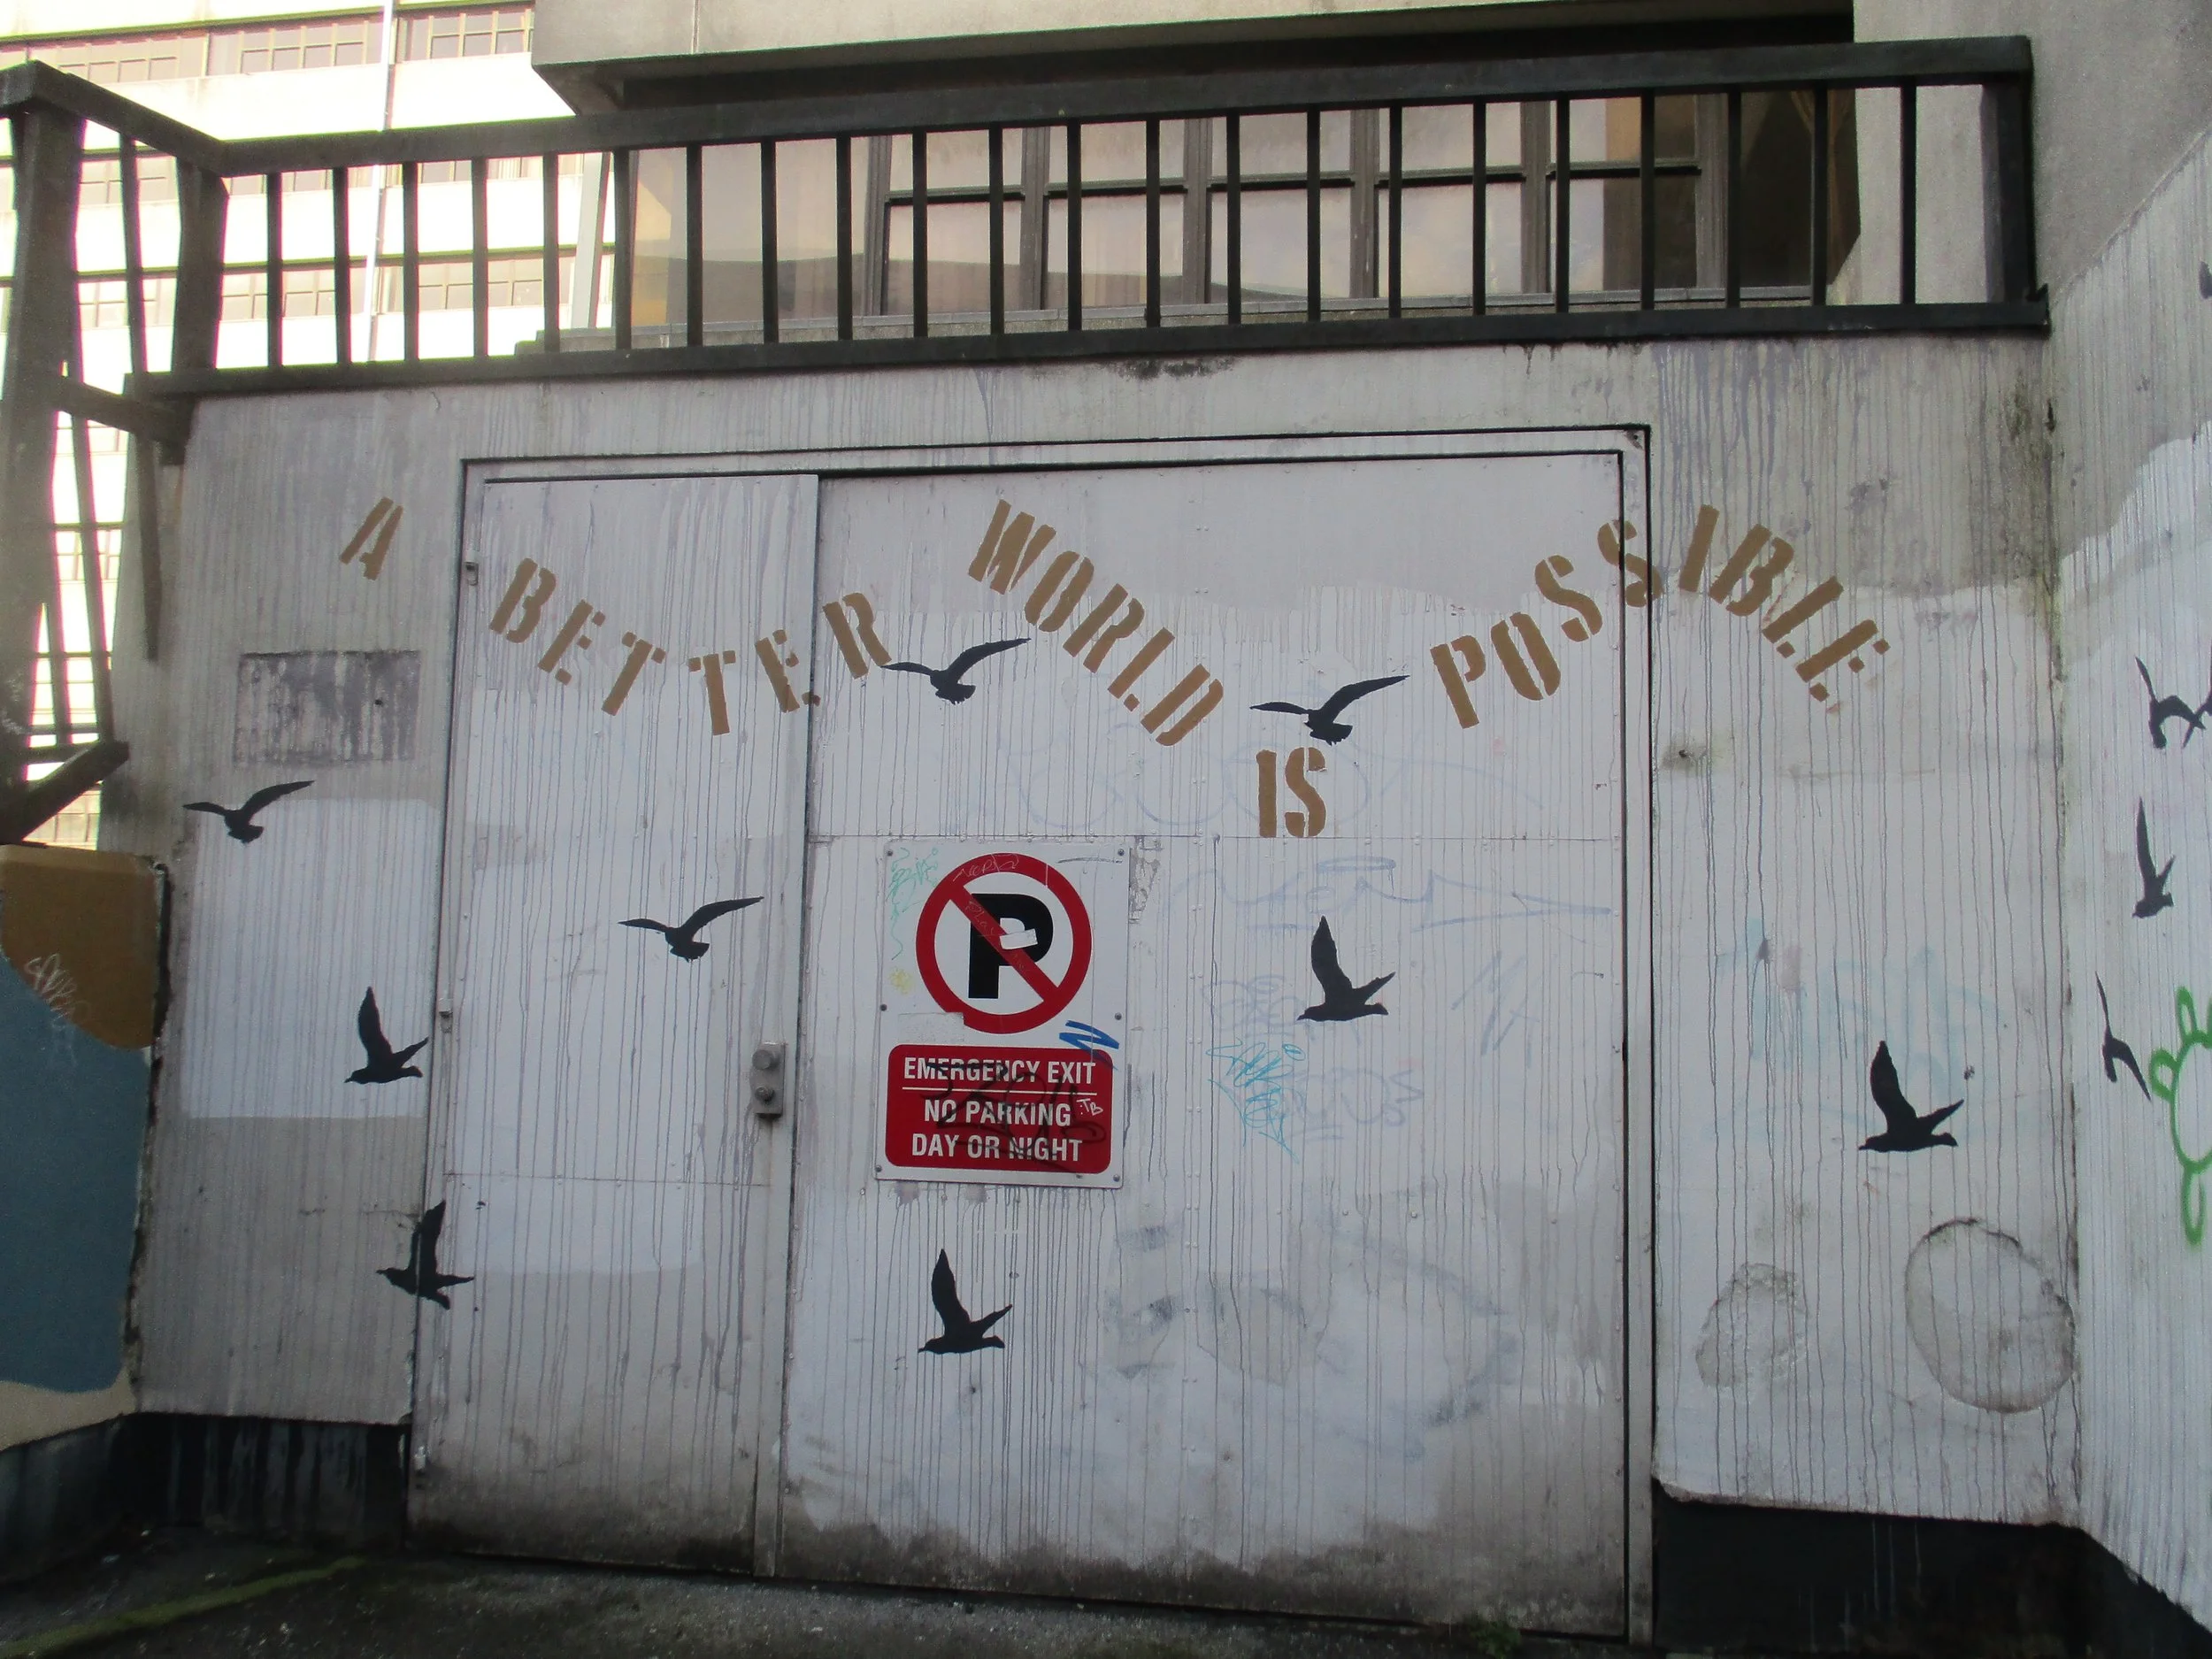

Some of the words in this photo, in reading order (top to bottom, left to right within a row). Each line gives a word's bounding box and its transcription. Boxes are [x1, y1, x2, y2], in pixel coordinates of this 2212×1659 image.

[340, 496, 403, 580] A
[488, 557, 892, 735] BETTER
[968, 499, 1224, 747] WORLD
[1256, 747, 1327, 838] IS
[1430, 504, 1891, 728] POSSIBLE
[903, 1056, 1041, 1083] EMERGENCY
[1047, 1061, 1096, 1085] EXIT
[924, 1099, 957, 1123] NO
[965, 1101, 1071, 1127] PARKING
[911, 1133, 960, 1157] DAY
[967, 1134, 1000, 1159] OR
[1009, 1137, 1083, 1162] NIGHT
